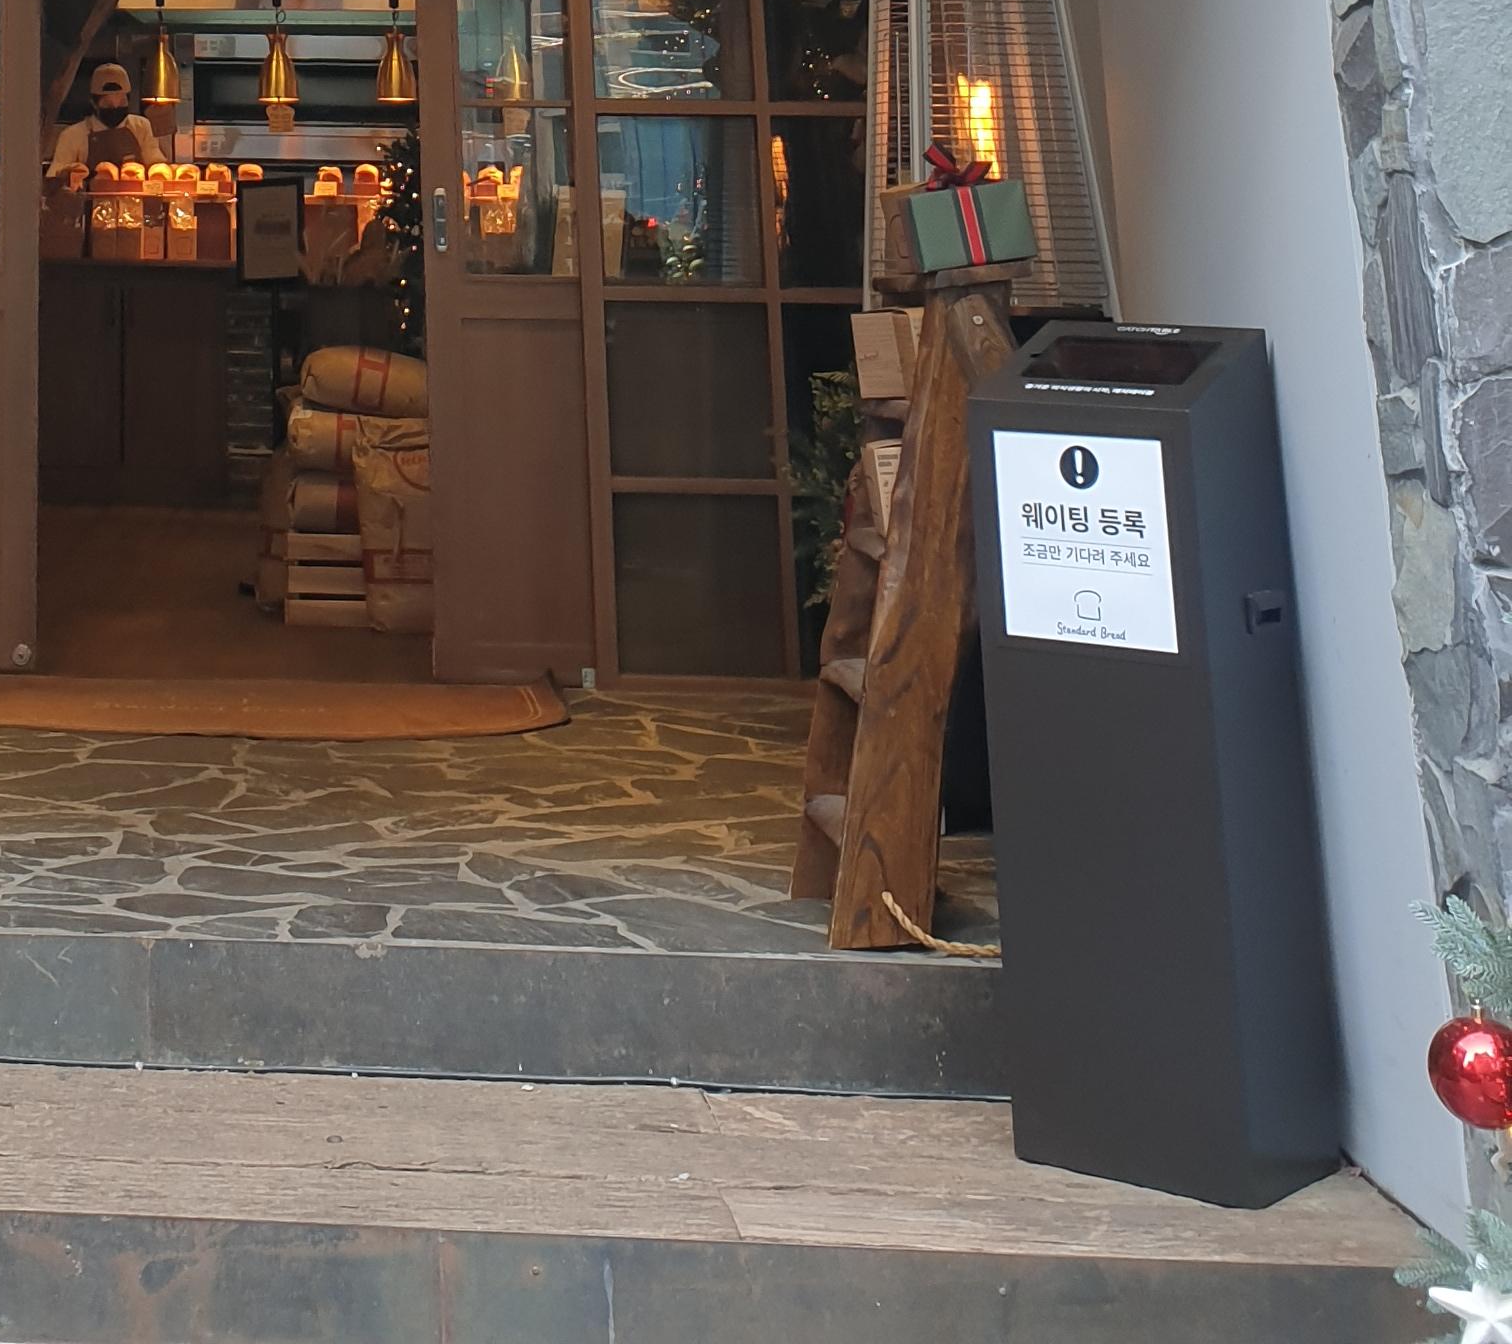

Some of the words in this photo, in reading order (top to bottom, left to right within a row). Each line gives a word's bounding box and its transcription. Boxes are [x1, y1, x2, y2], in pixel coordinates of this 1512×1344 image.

[1021, 501, 1090, 534] 웨이팅
[1097, 508, 1147, 539] 등록
[1022, 542, 1062, 562] 조금만
[1065, 545, 1106, 566] 기다려
[1109, 549, 1151, 569] 주세요
[1056, 620, 1097, 638] Standard
[1099, 626, 1127, 642] Bread
